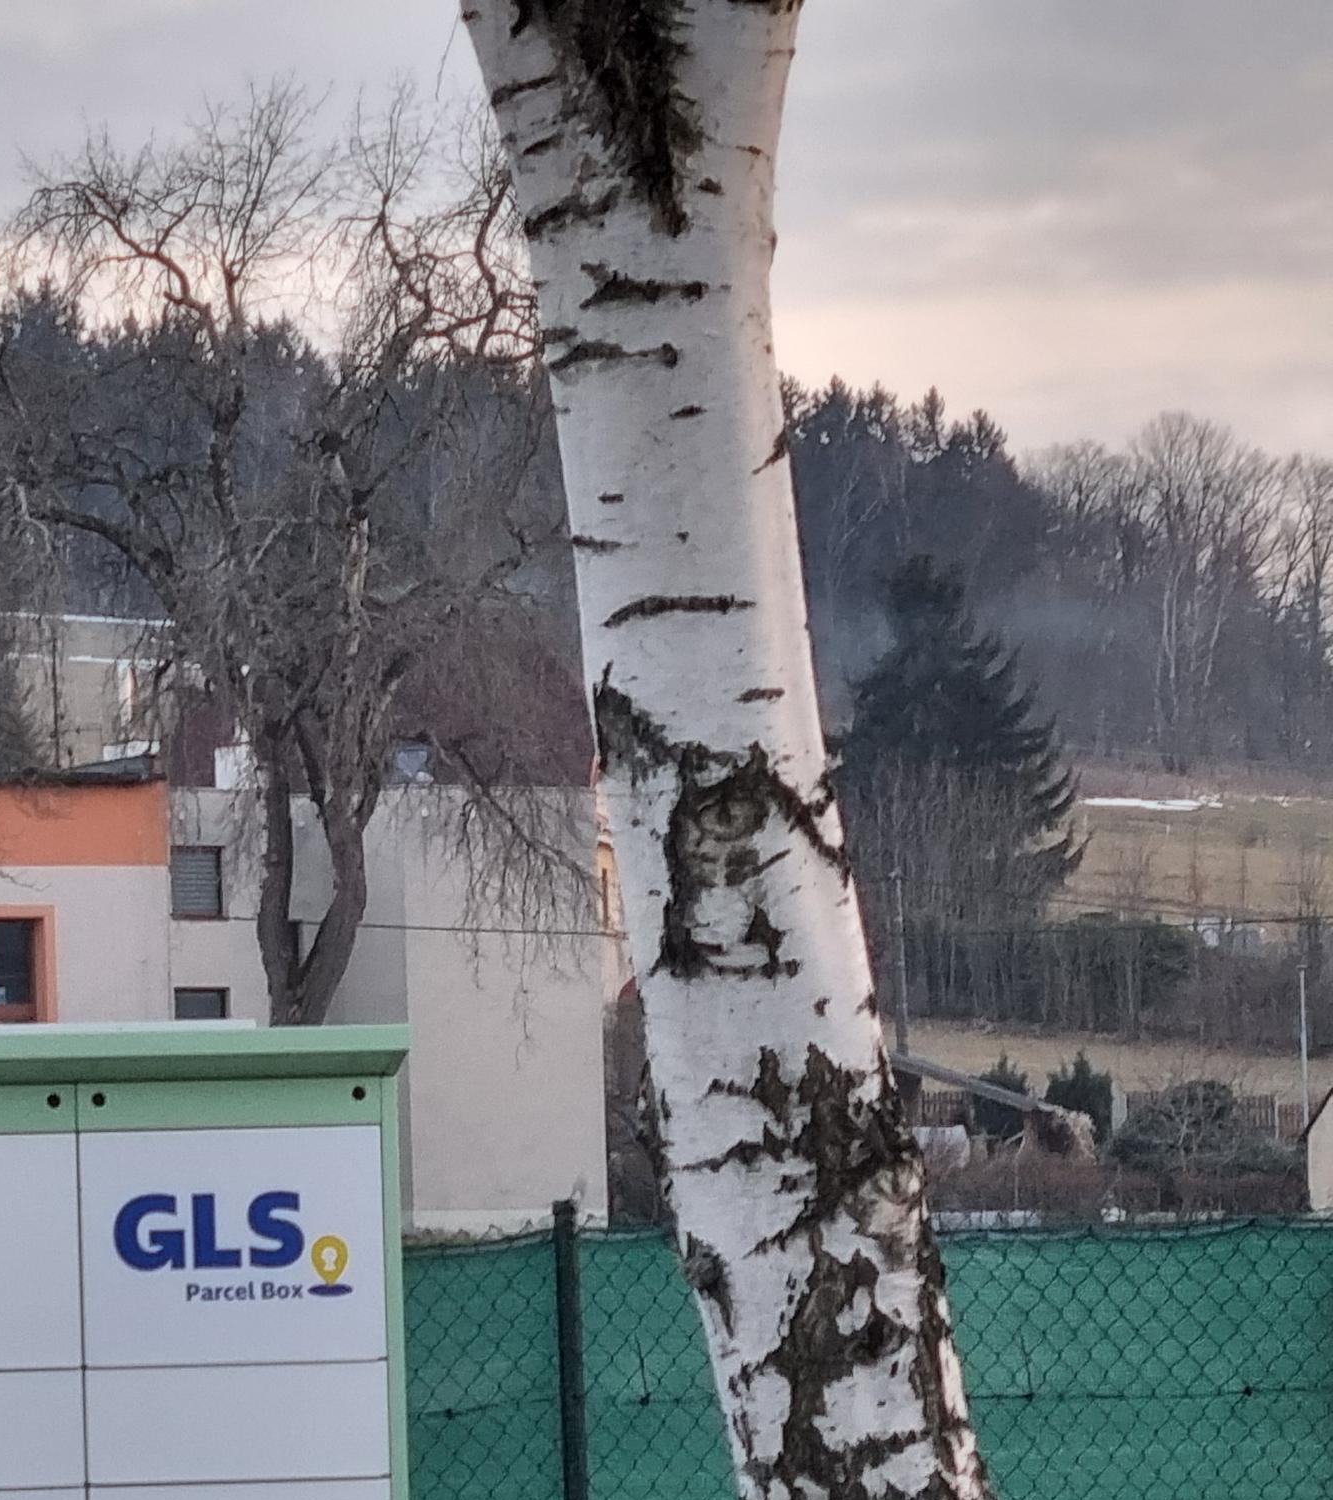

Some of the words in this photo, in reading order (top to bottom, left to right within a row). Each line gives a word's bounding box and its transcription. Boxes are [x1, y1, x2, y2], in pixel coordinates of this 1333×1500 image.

[113, 1190, 305, 1271] GLS
[186, 1281, 256, 1302] Parcel
[261, 1281, 304, 1300] Box
